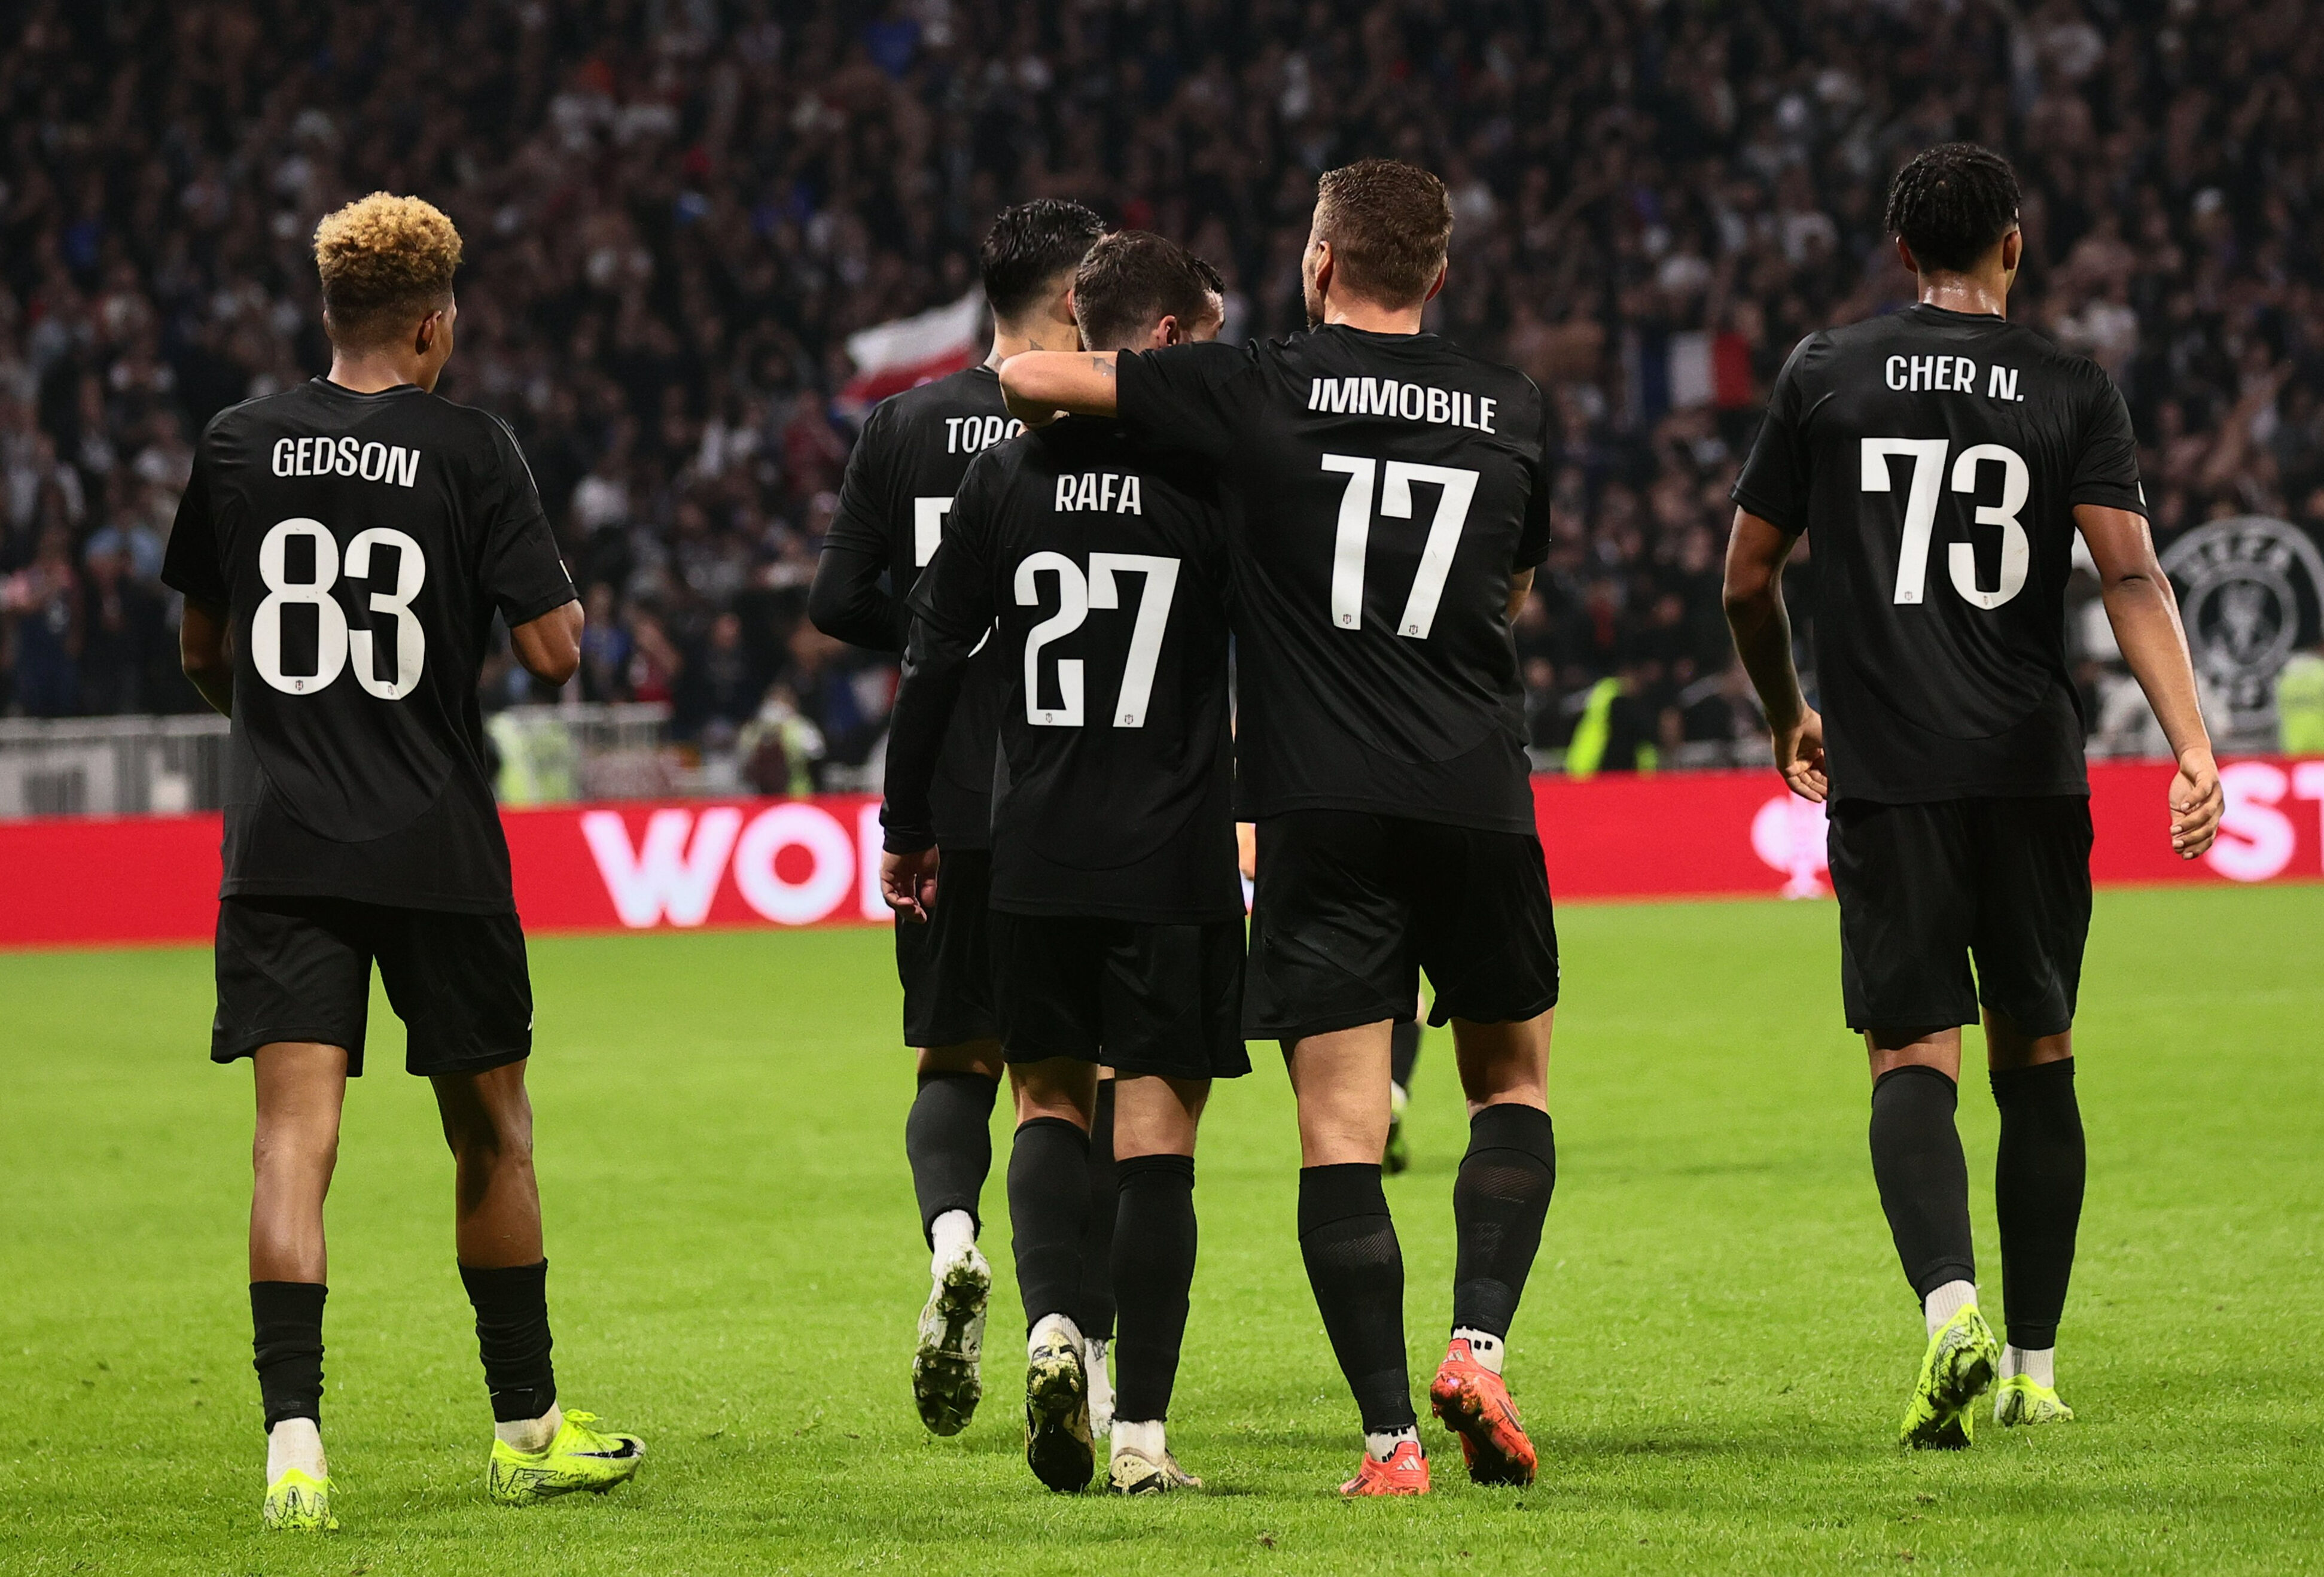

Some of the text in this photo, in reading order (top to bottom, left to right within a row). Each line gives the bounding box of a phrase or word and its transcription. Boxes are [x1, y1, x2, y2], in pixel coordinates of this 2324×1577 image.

[1308, 377, 1497, 434] IMMOBILE
[1886, 355, 2024, 401] CHER N.
[272, 436, 421, 488] GEDSON
[1055, 473, 1141, 515] RAFA
[1321, 453, 1480, 640] 17
[1861, 437, 2030, 610] 73
[251, 517, 426, 701] 83
[1014, 551, 1181, 727] 27
